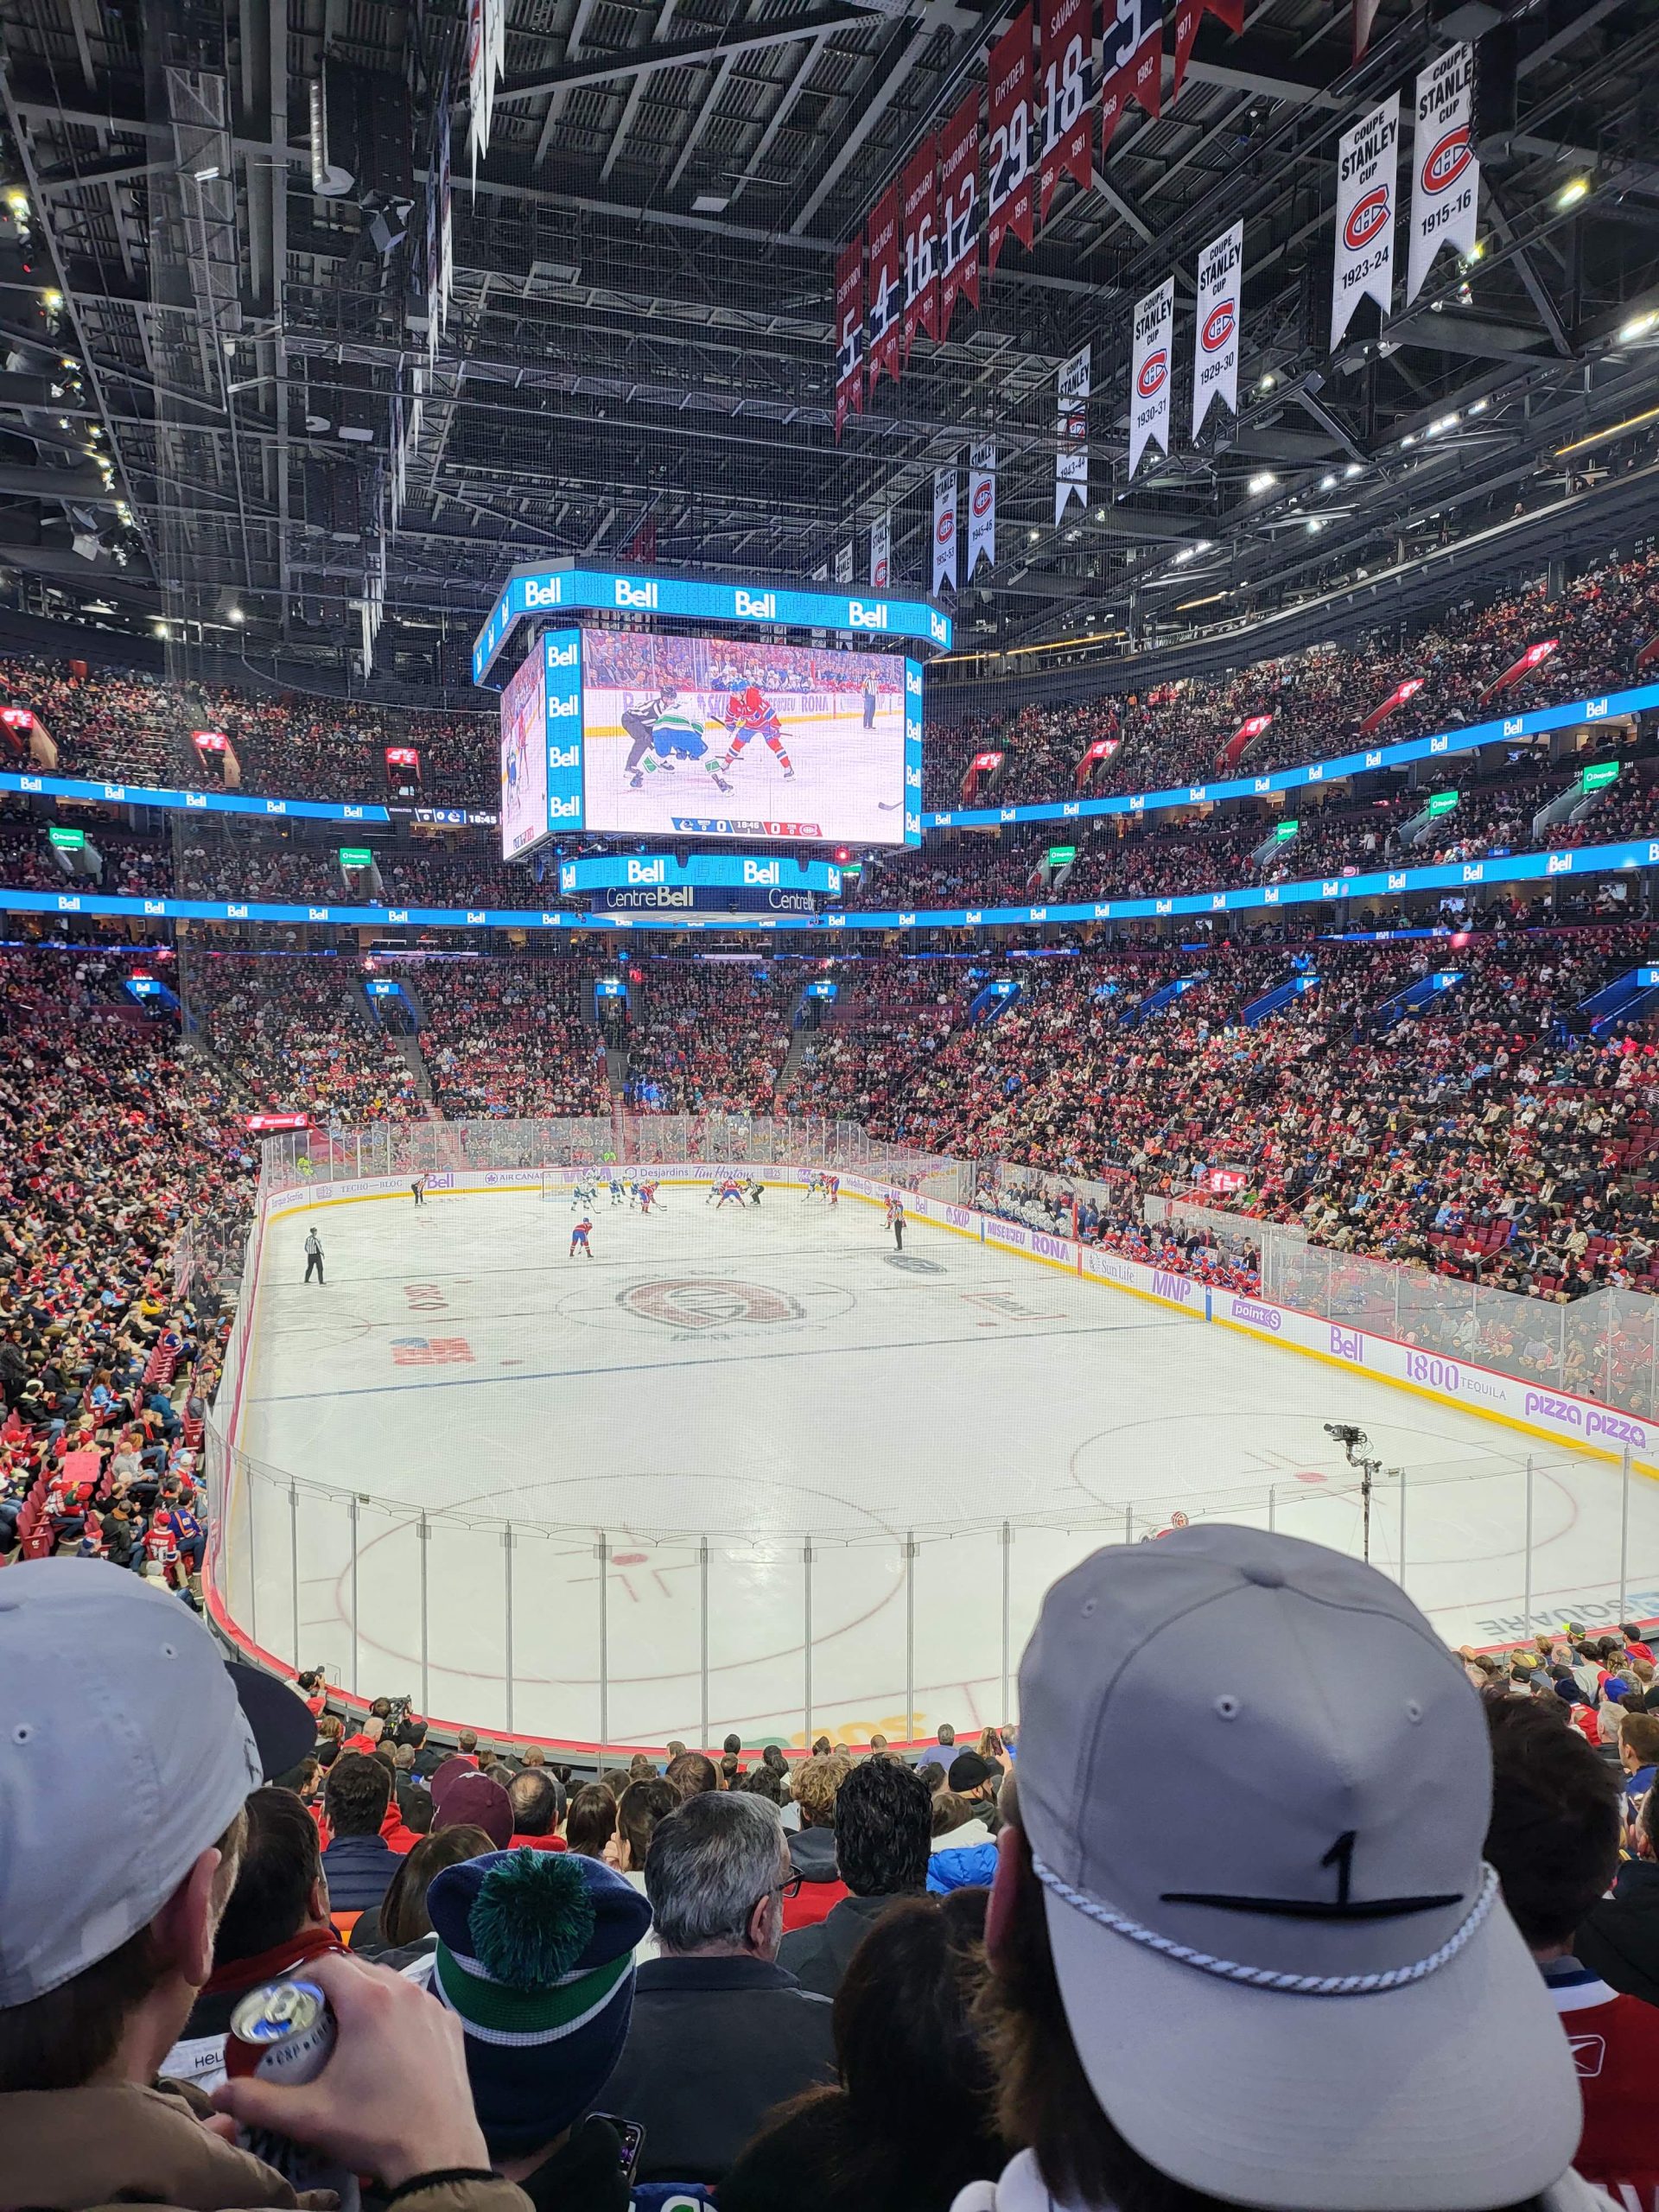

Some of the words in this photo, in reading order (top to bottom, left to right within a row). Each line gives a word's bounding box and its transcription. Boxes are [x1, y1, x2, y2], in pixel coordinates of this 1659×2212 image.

[1177, 12, 1192, 43] 1971
[1137, 56, 1154, 86] 1982
[1433, 45, 1469, 81] COUPE
[995, 55, 1025, 107] DRYDEN
[1419, 59, 1473, 121] STANLE
[1042, 34, 1083, 158] 18
[1439, 99, 1460, 124] CUP
[1354, 111, 1385, 145] COUPE
[942, 123, 978, 182] COURNOYER
[1071, 132, 1085, 157] 1981
[1341, 118, 1397, 181] STANLEY
[988, 99, 1027, 217] 29
[1359, 162, 1377, 185] CUP
[1014, 196, 1027, 219] 1979
[1421, 188, 1471, 237] 1915-16
[944, 172, 976, 277] 12
[1210, 235, 1232, 261] COUPE
[905, 213, 932, 310] 16
[1200, 242, 1241, 291] STANLEY
[1342, 245, 1389, 289] 1923-24
[1212, 278, 1226, 296] CUP
[1143, 289, 1164, 313] COUPE
[1135, 297, 1173, 340] STANLEY
[1147, 329, 1159, 346] CUP
[1200, 352, 1234, 385] 1929-30
[1060, 363, 1090, 401] STANLEY
[1137, 397, 1166, 428] 1930-31
[525, 577, 562, 607] Bell
[615, 579, 658, 608] Bell
[735, 591, 776, 619] Bell
[849, 601, 887, 629] Bell
[931, 612, 946, 644] Bell
[548, 644, 578, 668] Bell
[906, 671, 921, 696] Bell
[549, 695, 578, 718] Bell
[1586, 699, 1607, 718] Bell
[906, 718, 921, 742] Bell
[1503, 718, 1522, 736] Bell
[1431, 736, 1447, 753] Bell
[550, 746, 579, 768] Bell
[1366, 752, 1382, 767] Bell
[21, 778, 41, 791] Bell
[906, 765, 921, 788] Bell
[1255, 778, 1270, 791] Bell
[1309, 766, 1323, 781] Bell
[105, 786, 125, 800] Bell
[186, 795, 207, 807] Bell
[1130, 796, 1144, 809] Bell
[1190, 788, 1205, 801] Bell
[267, 801, 286, 814] Bell
[344, 806, 362, 818] Bell
[550, 796, 580, 817] Bell
[1001, 810, 1015, 821] Bell
[1064, 803, 1079, 816] Bell
[716, 820, 726, 832] 0
[771, 823, 780, 835] 0
[906, 812, 920, 834] Bell
[935, 814, 950, 825] Bell
[627, 860, 664, 884] Bell
[743, 861, 779, 885] Bell
[1463, 864, 1483, 881] Bell
[1548, 855, 1572, 873] Bell
[563, 866, 576, 889] Bell
[1323, 881, 1338, 896] Bell
[1388, 874, 1406, 889] Bell
[58, 897, 80, 910] Bell
[1156, 900, 1172, 913] Bell
[1212, 895, 1226, 908] Bell
[1265, 889, 1279, 902] Bell
[144, 901, 165, 914] Bell
[227, 906, 248, 918] Bell
[309, 909, 328, 920] Bell
[389, 911, 408, 922] Bell
[467, 912, 486, 924] Bell
[966, 912, 982, 923] Bell
[1030, 908, 1046, 920] Bell
[1095, 905, 1109, 917] Bell
[543, 913, 561, 925] Bell
[829, 915, 845, 926] Bell
[899, 914, 915, 925] Bell
[428, 1173, 454, 1189] Bell
[640, 1168, 689, 1179] Desjardins
[693, 1166, 712, 1179] Tim
[713, 1166, 754, 1179] Hortons
[952, 1207, 970, 1229] SKIP
[1032, 1233, 1070, 1262] RONA
[1102, 1259, 1117, 1278] Sun
[1117, 1264, 1135, 1283] Life
[1153, 1270, 1192, 1301] MNP
[1236, 1305, 1264, 1320] point
[1270, 1313, 1280, 1328] S
[1330, 1325, 1363, 1363] Bell
[1405, 1351, 1459, 1392] 1800
[1460, 1376, 1507, 1401] TEQUILA
[1525, 1392, 1581, 1426] pizza
[1586, 1411, 1646, 1449] pizza
[1475, 1599, 1635, 1637] SQUARE
